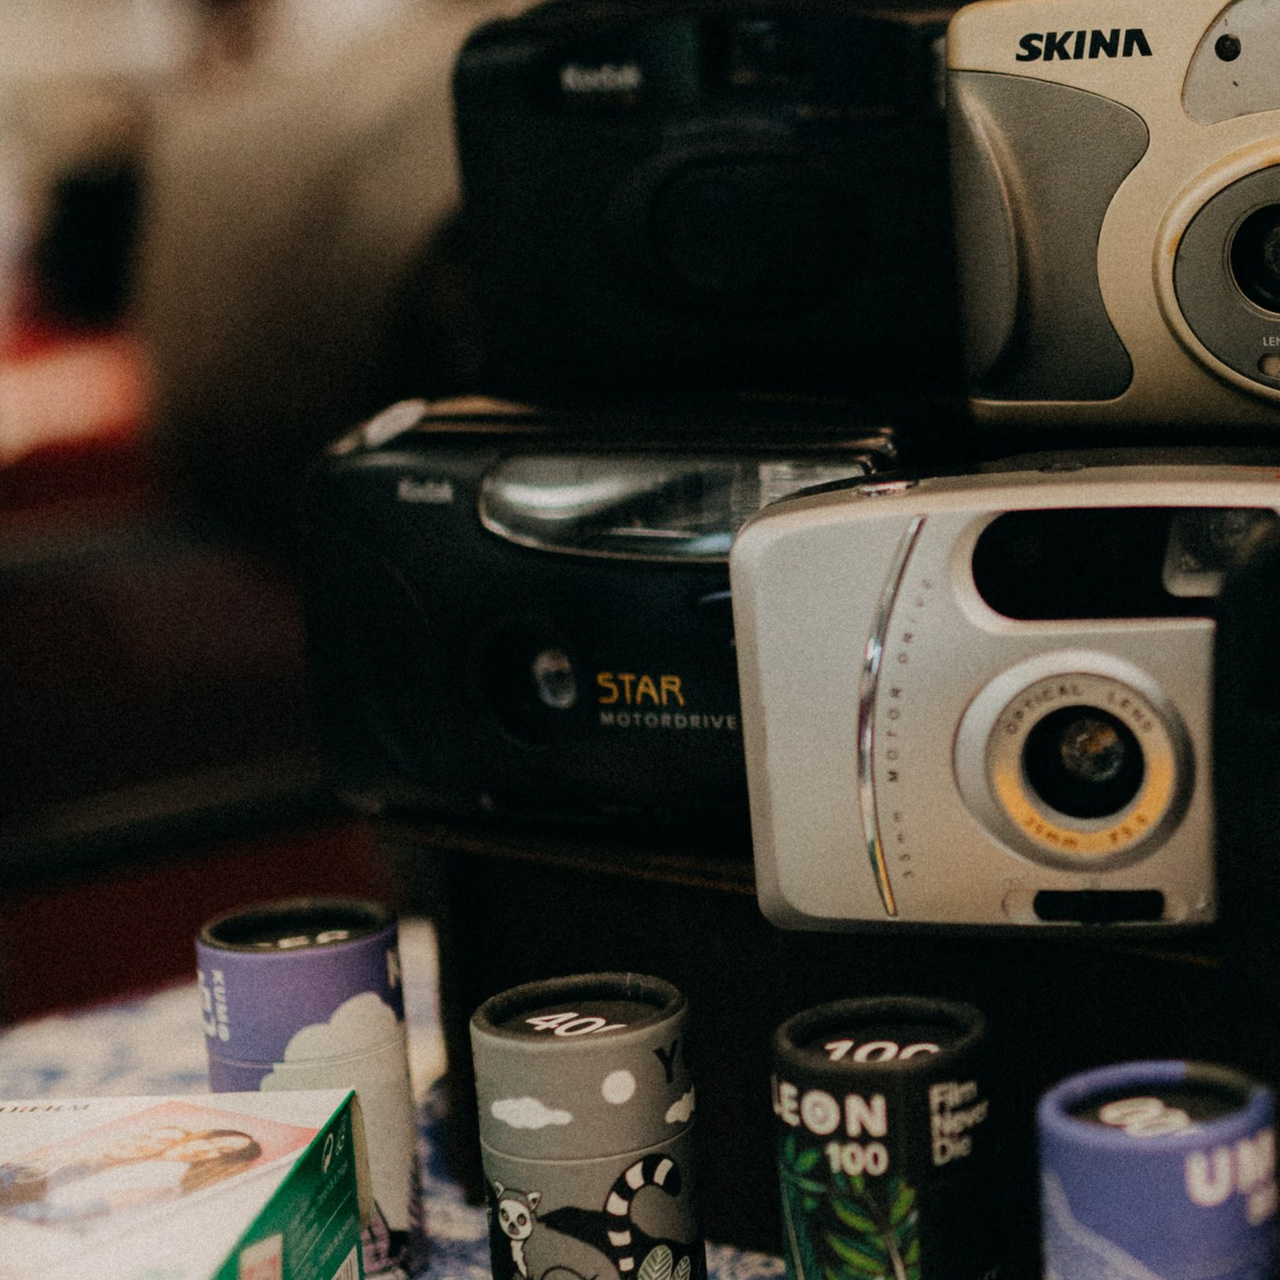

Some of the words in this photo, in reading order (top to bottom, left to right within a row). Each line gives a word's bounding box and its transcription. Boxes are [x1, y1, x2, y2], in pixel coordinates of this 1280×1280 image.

[1015, 28, 1153, 63] SKINA
[597, 672, 686, 707] STAR
[886, 684, 901, 783] MOTOR
[525, 1011, 629, 1037] 40
[825, 1140, 890, 1177] 100
